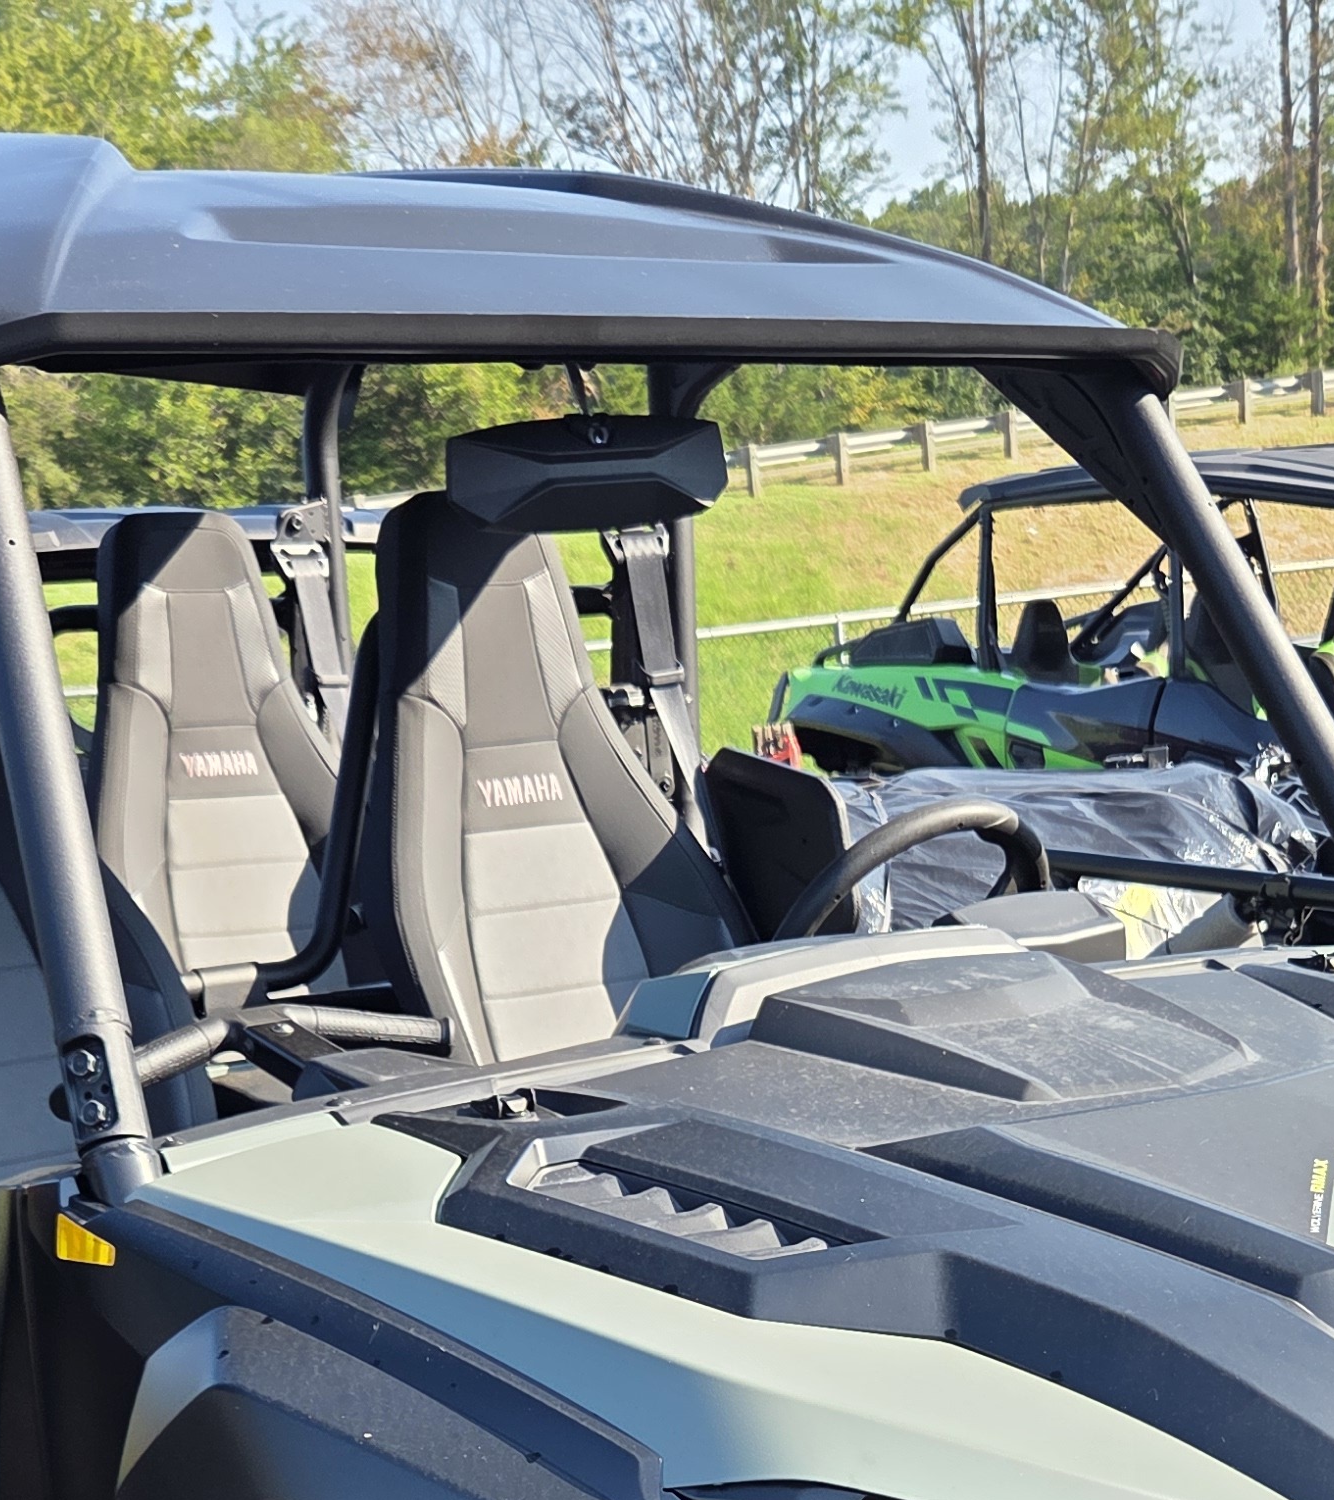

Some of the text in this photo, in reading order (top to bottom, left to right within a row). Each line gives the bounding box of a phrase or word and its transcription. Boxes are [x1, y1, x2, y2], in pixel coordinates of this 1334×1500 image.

[831, 674, 908, 710] Kawasaki
[179, 750, 259, 778] YAMAHA
[476, 772, 563, 808] YAMAHA
[1309, 1158, 1329, 1193] RMAX
